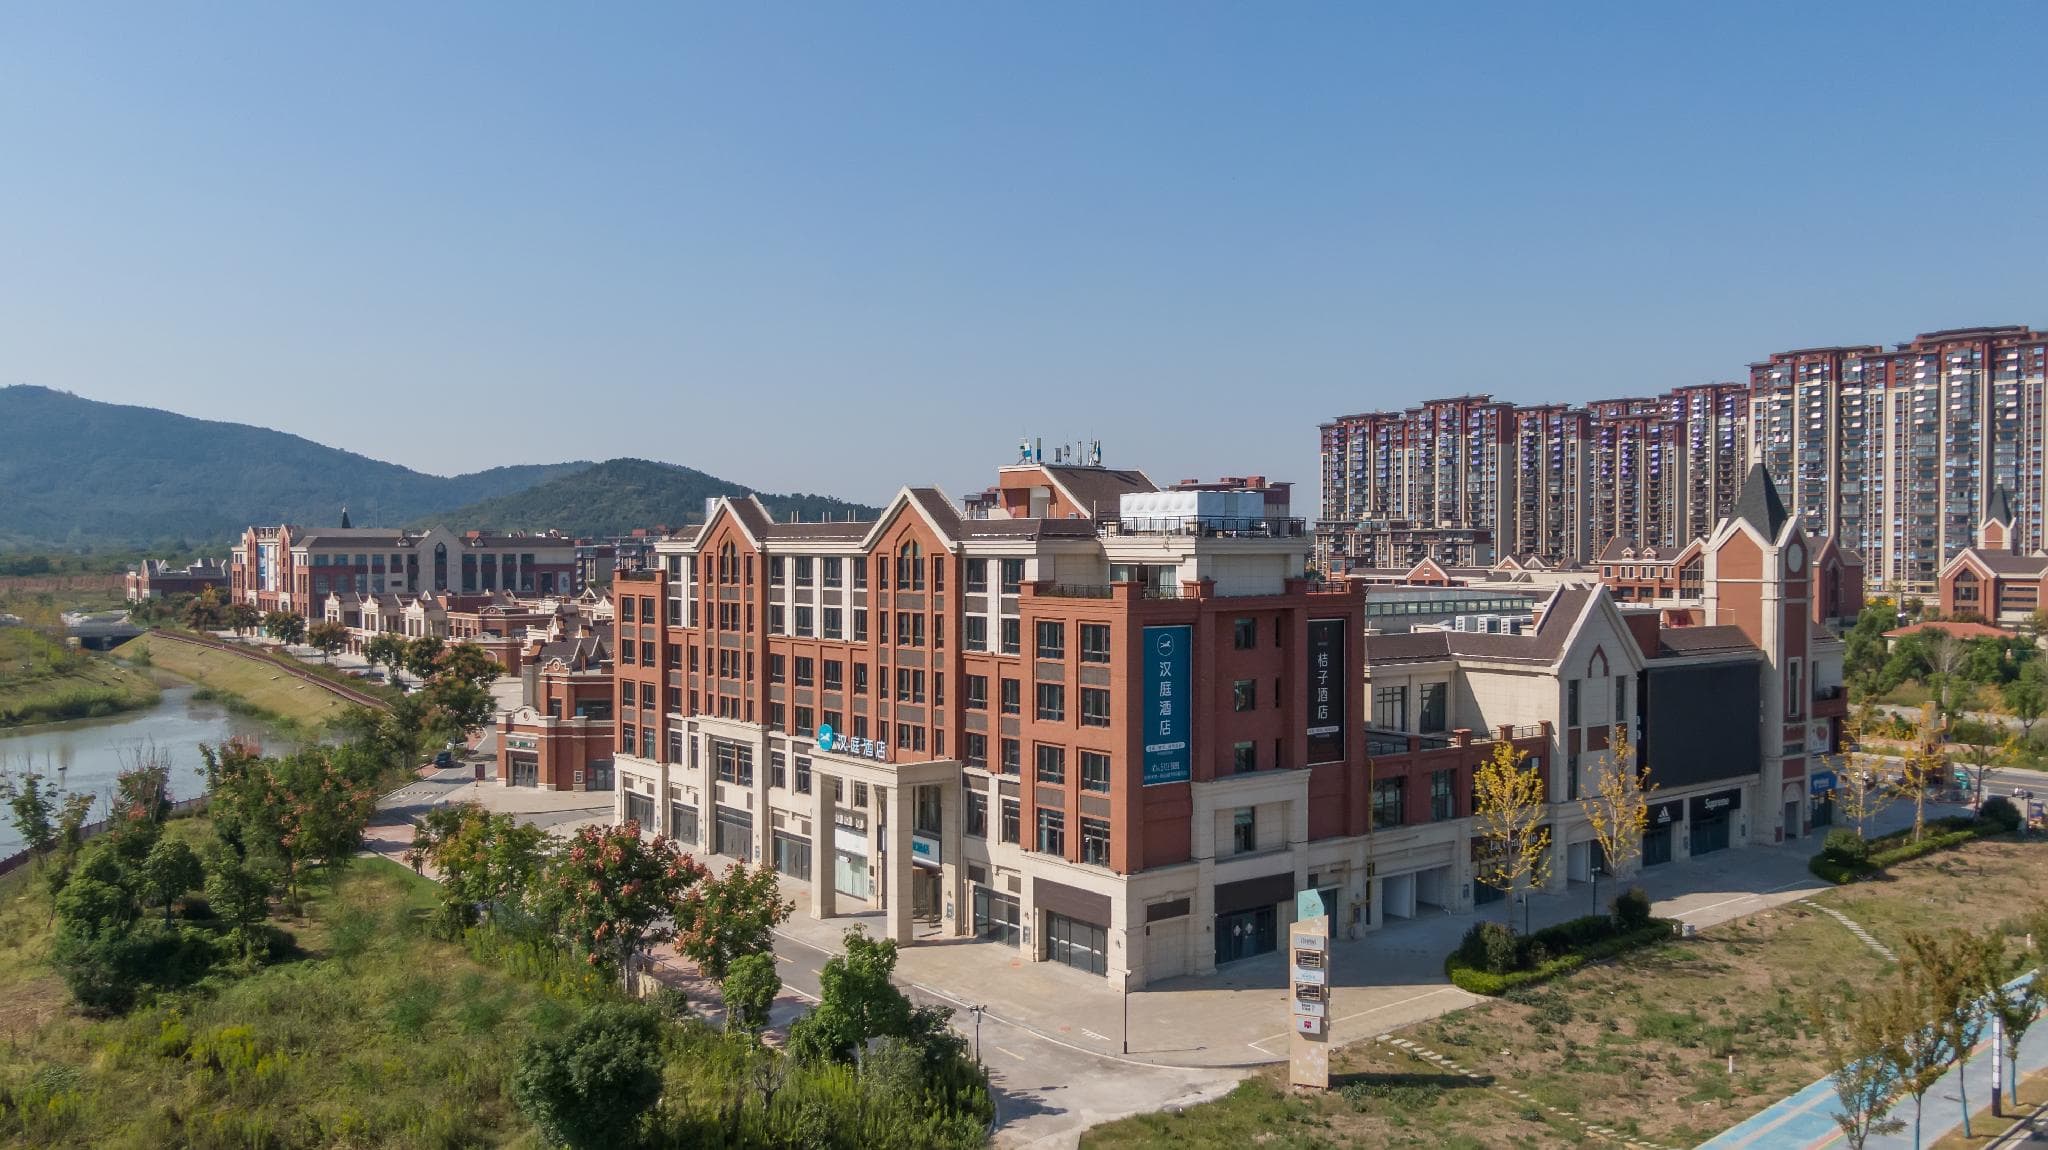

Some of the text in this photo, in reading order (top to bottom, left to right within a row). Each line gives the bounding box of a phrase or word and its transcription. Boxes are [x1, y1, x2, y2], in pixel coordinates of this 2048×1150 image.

[1159, 661, 1172, 736] 汉庭酒店
[1317, 652, 1329, 720] 桔子酒店
[833, 733, 885, 759] 汉庭酒店
